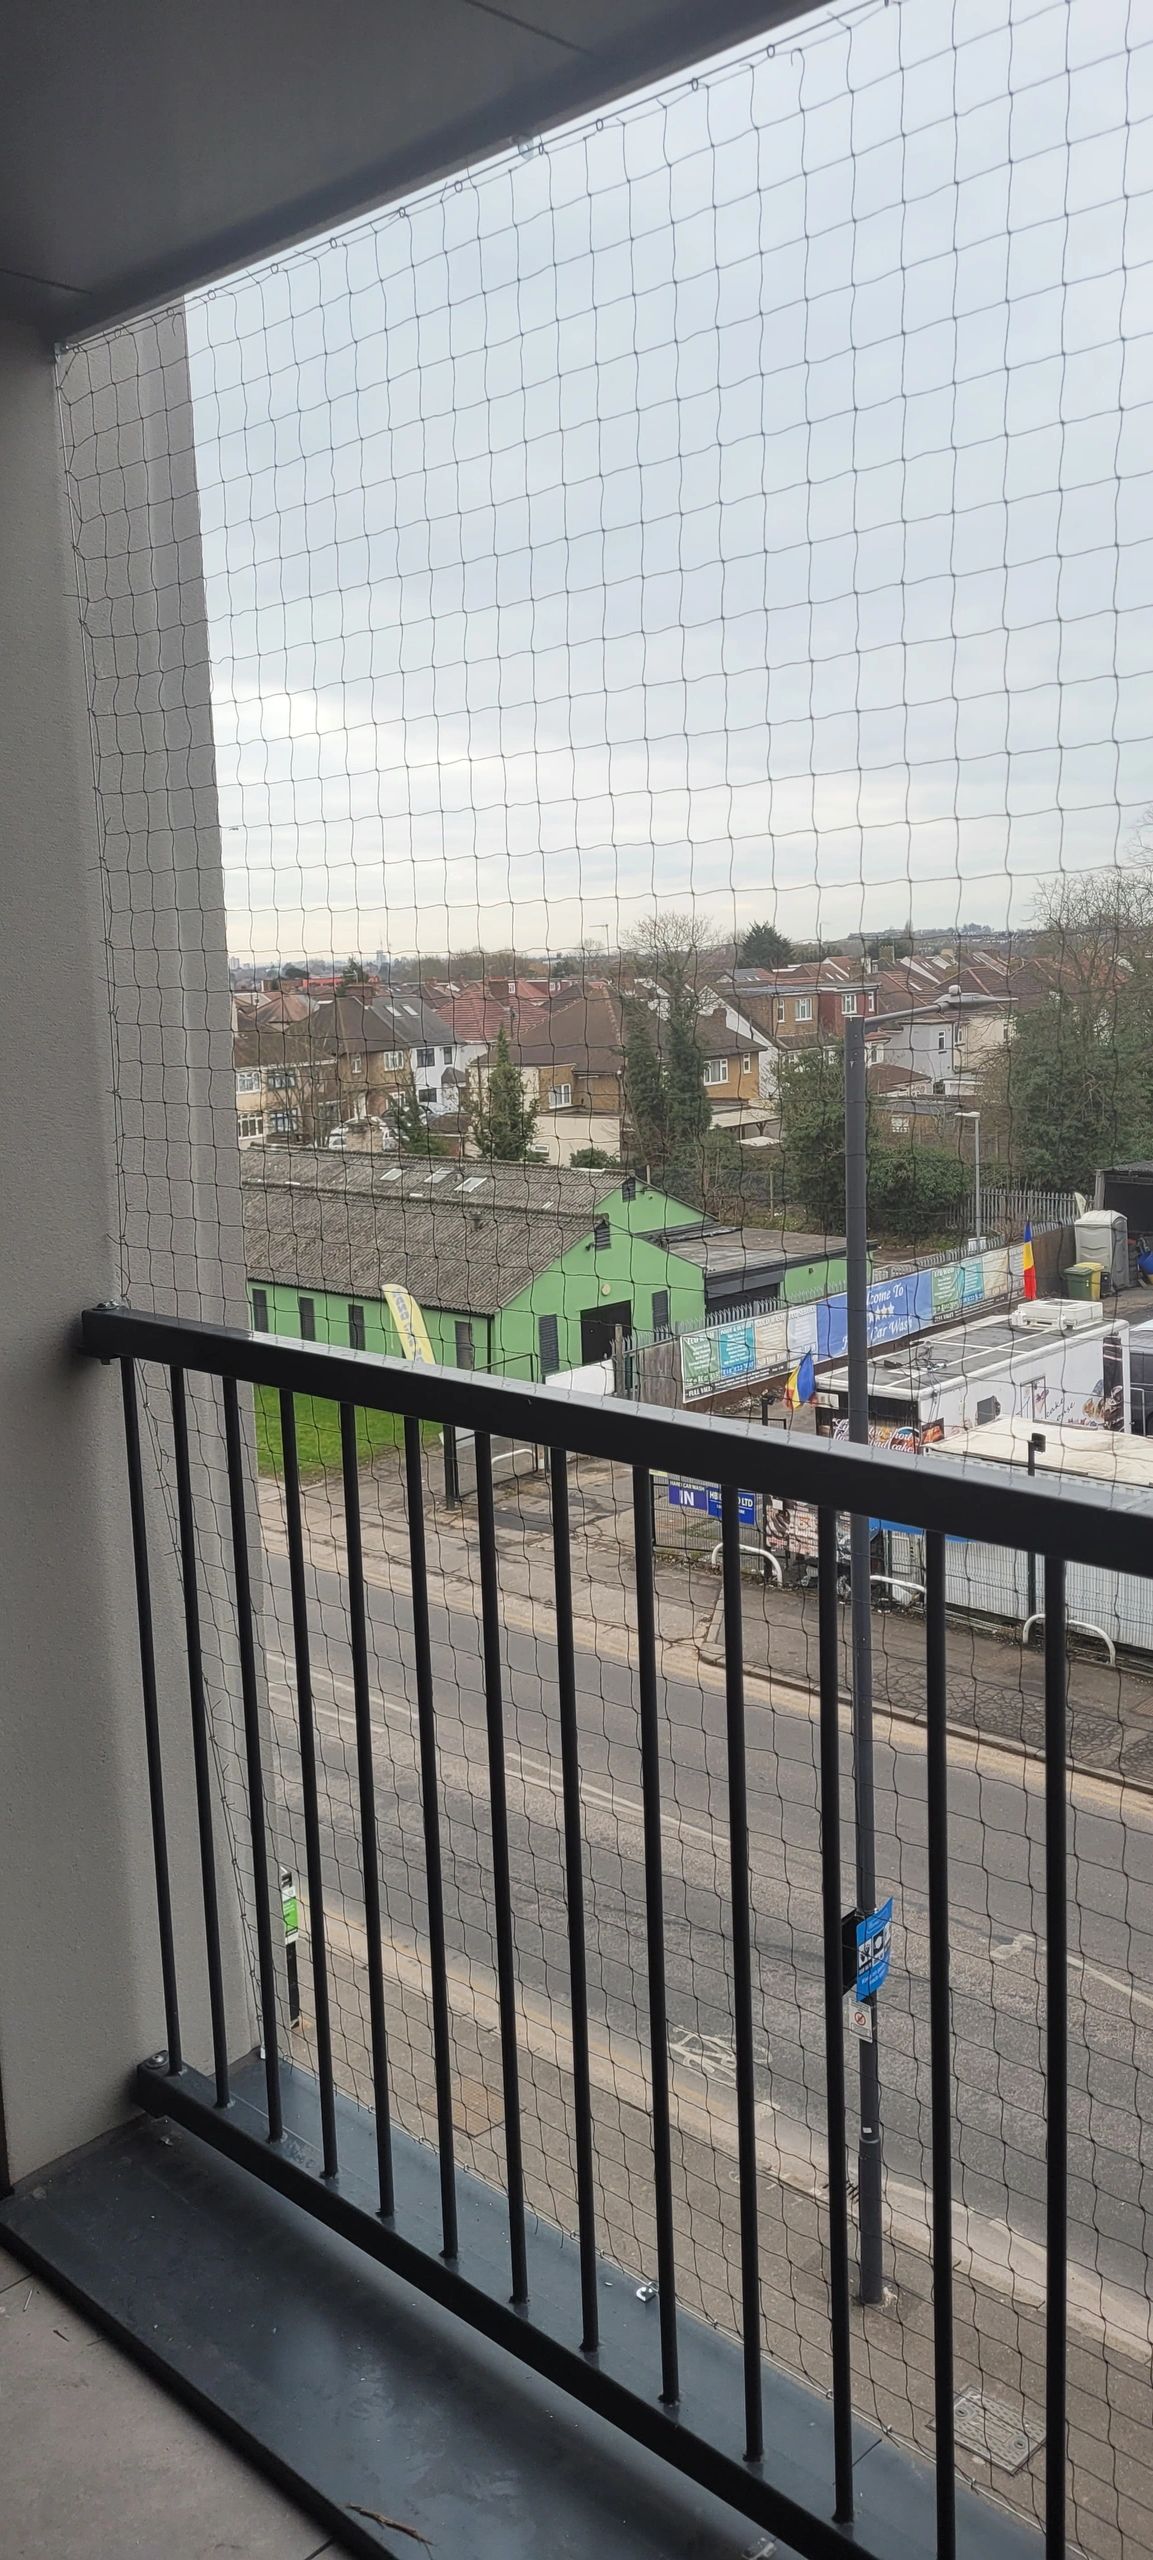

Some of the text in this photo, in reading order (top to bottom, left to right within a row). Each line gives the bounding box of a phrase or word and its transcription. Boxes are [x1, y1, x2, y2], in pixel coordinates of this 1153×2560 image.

[893, 1282, 904, 1297] To
[870, 1316, 913, 1342] Car Wash
[680, 1490, 694, 1506] IN
[741, 1498, 754, 1508] LTD
